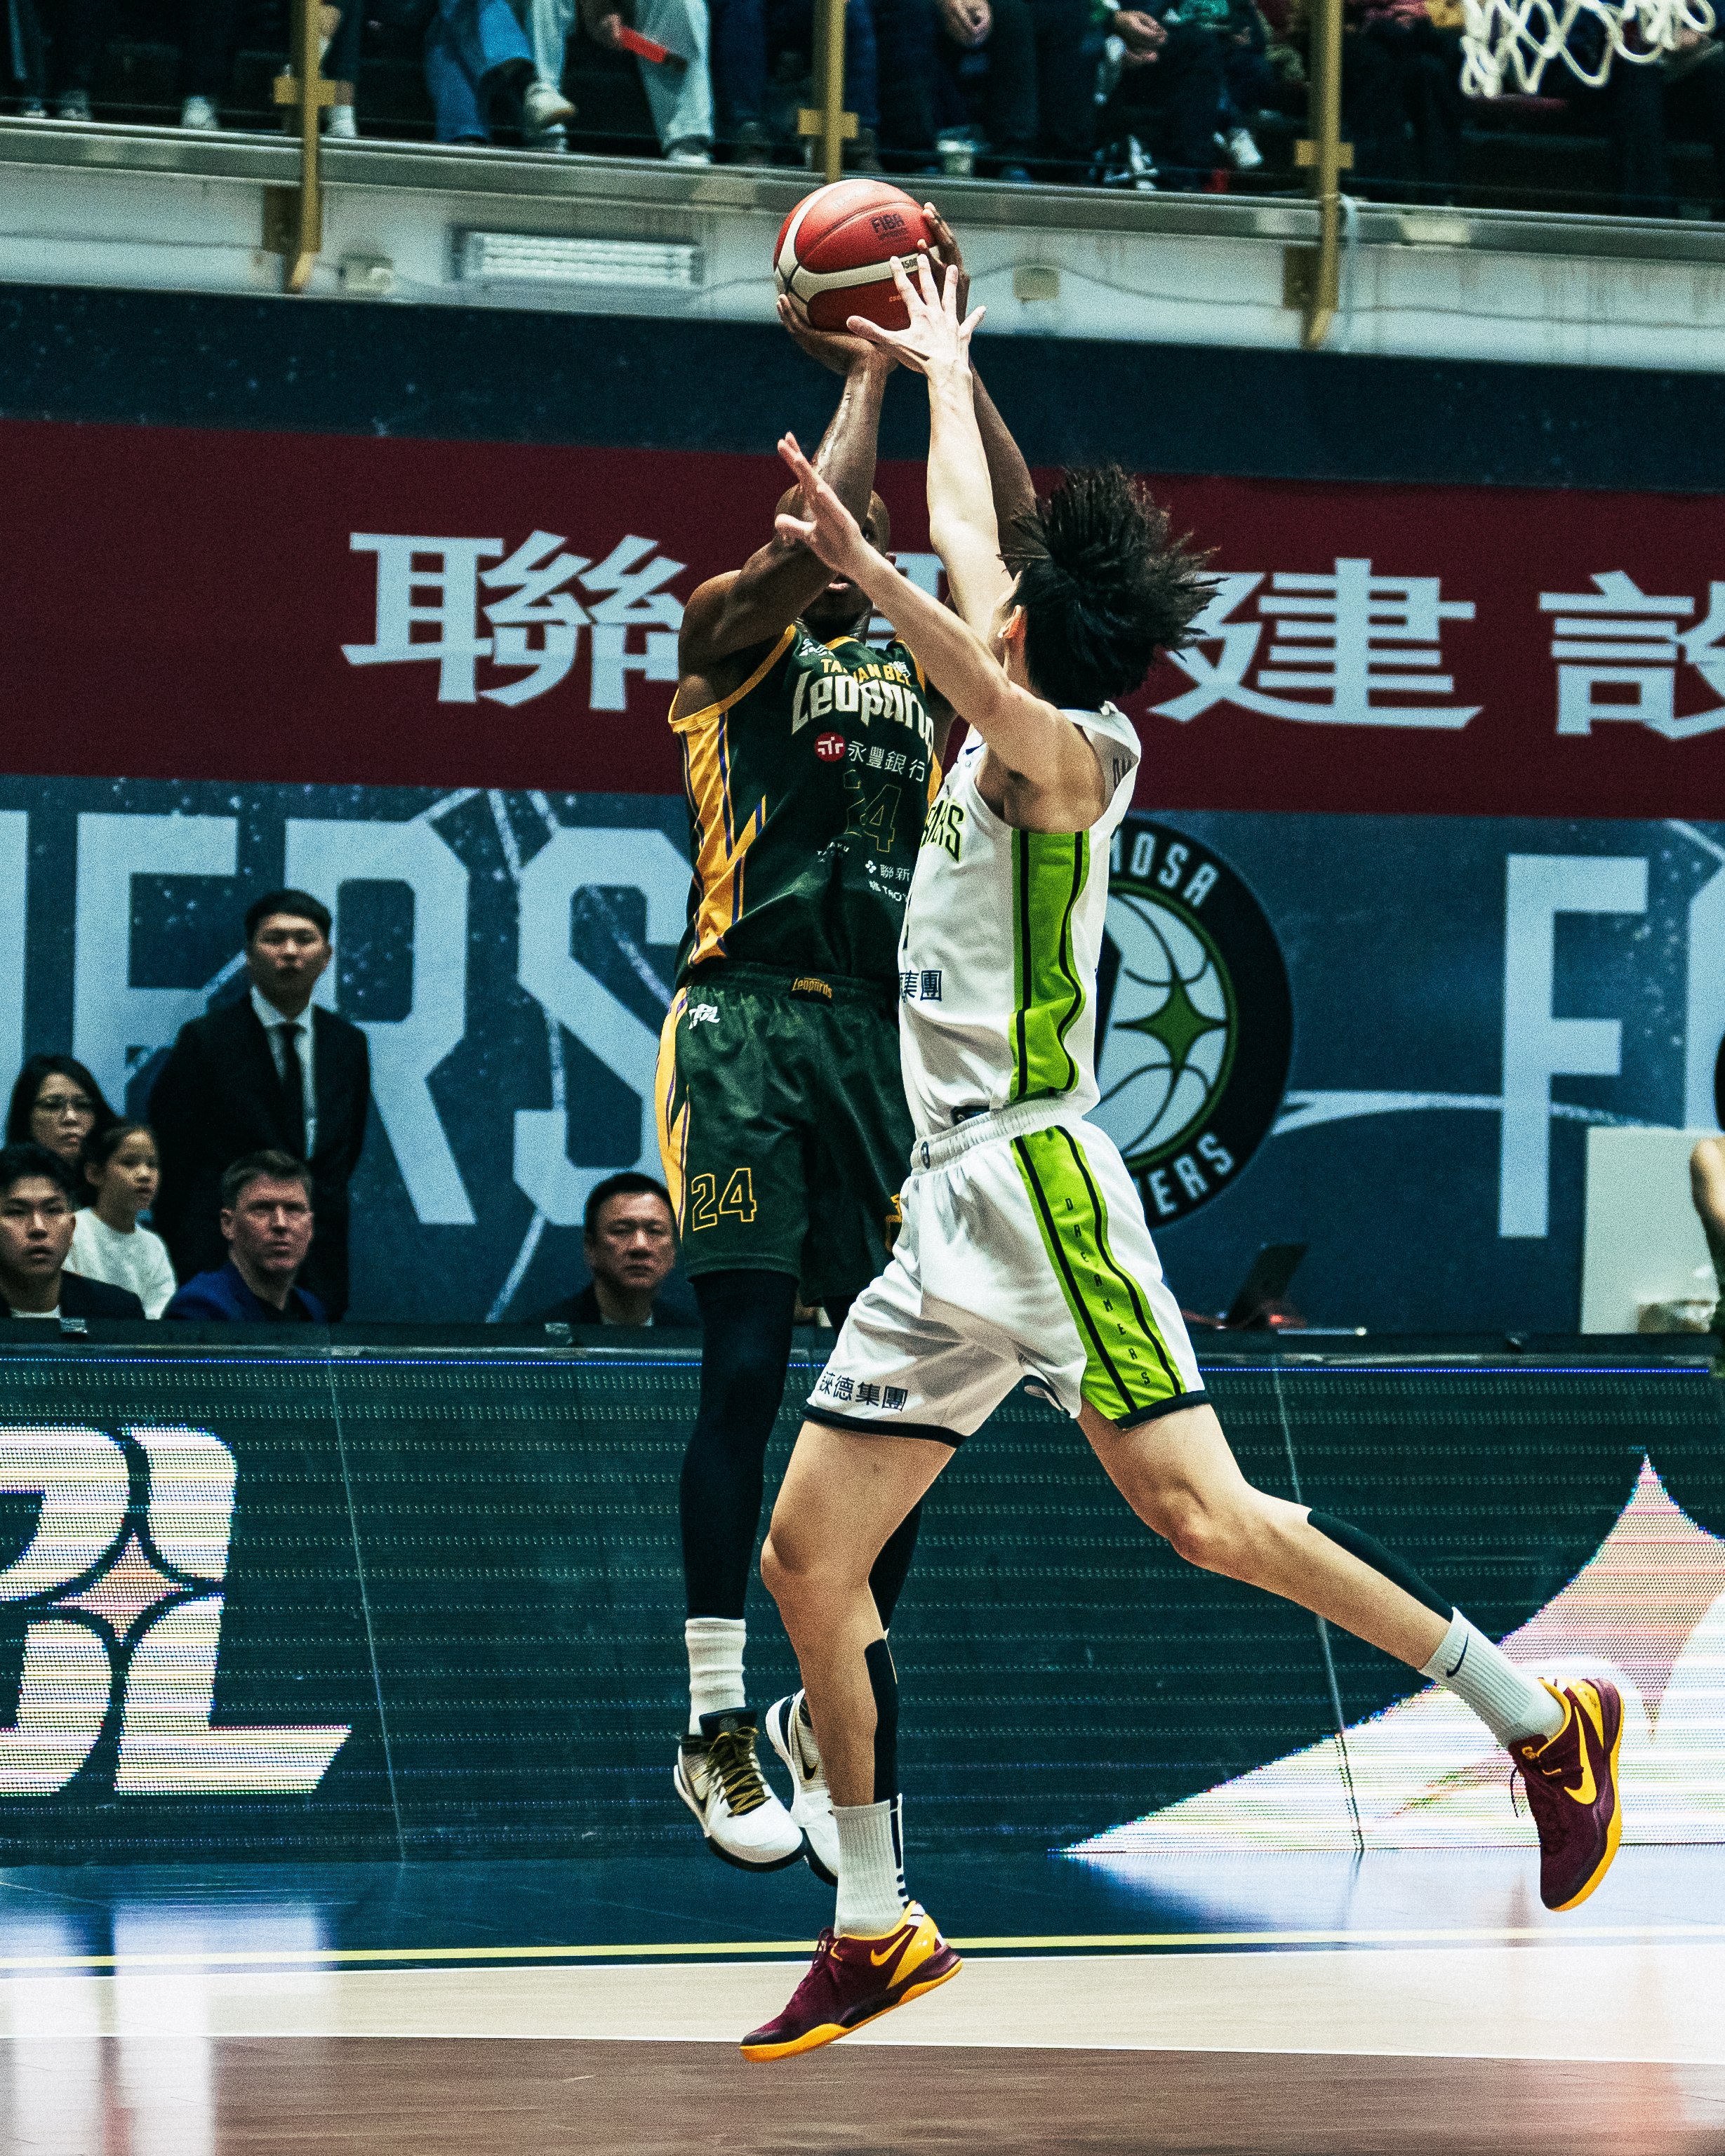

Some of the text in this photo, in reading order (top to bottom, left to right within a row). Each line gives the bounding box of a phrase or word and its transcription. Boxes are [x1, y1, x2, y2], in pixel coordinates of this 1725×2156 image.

[870, 213, 905, 234] FIBA
[848, 740, 925, 783] 永豐銀行
[0, 809, 691, 1225] ERS
[791, 977, 832, 999] Leopards
[691, 1167, 757, 1232] 24
[1133, 1132, 1234, 1216] ERS
[1065, 1197, 1151, 1386] DREAMERS
